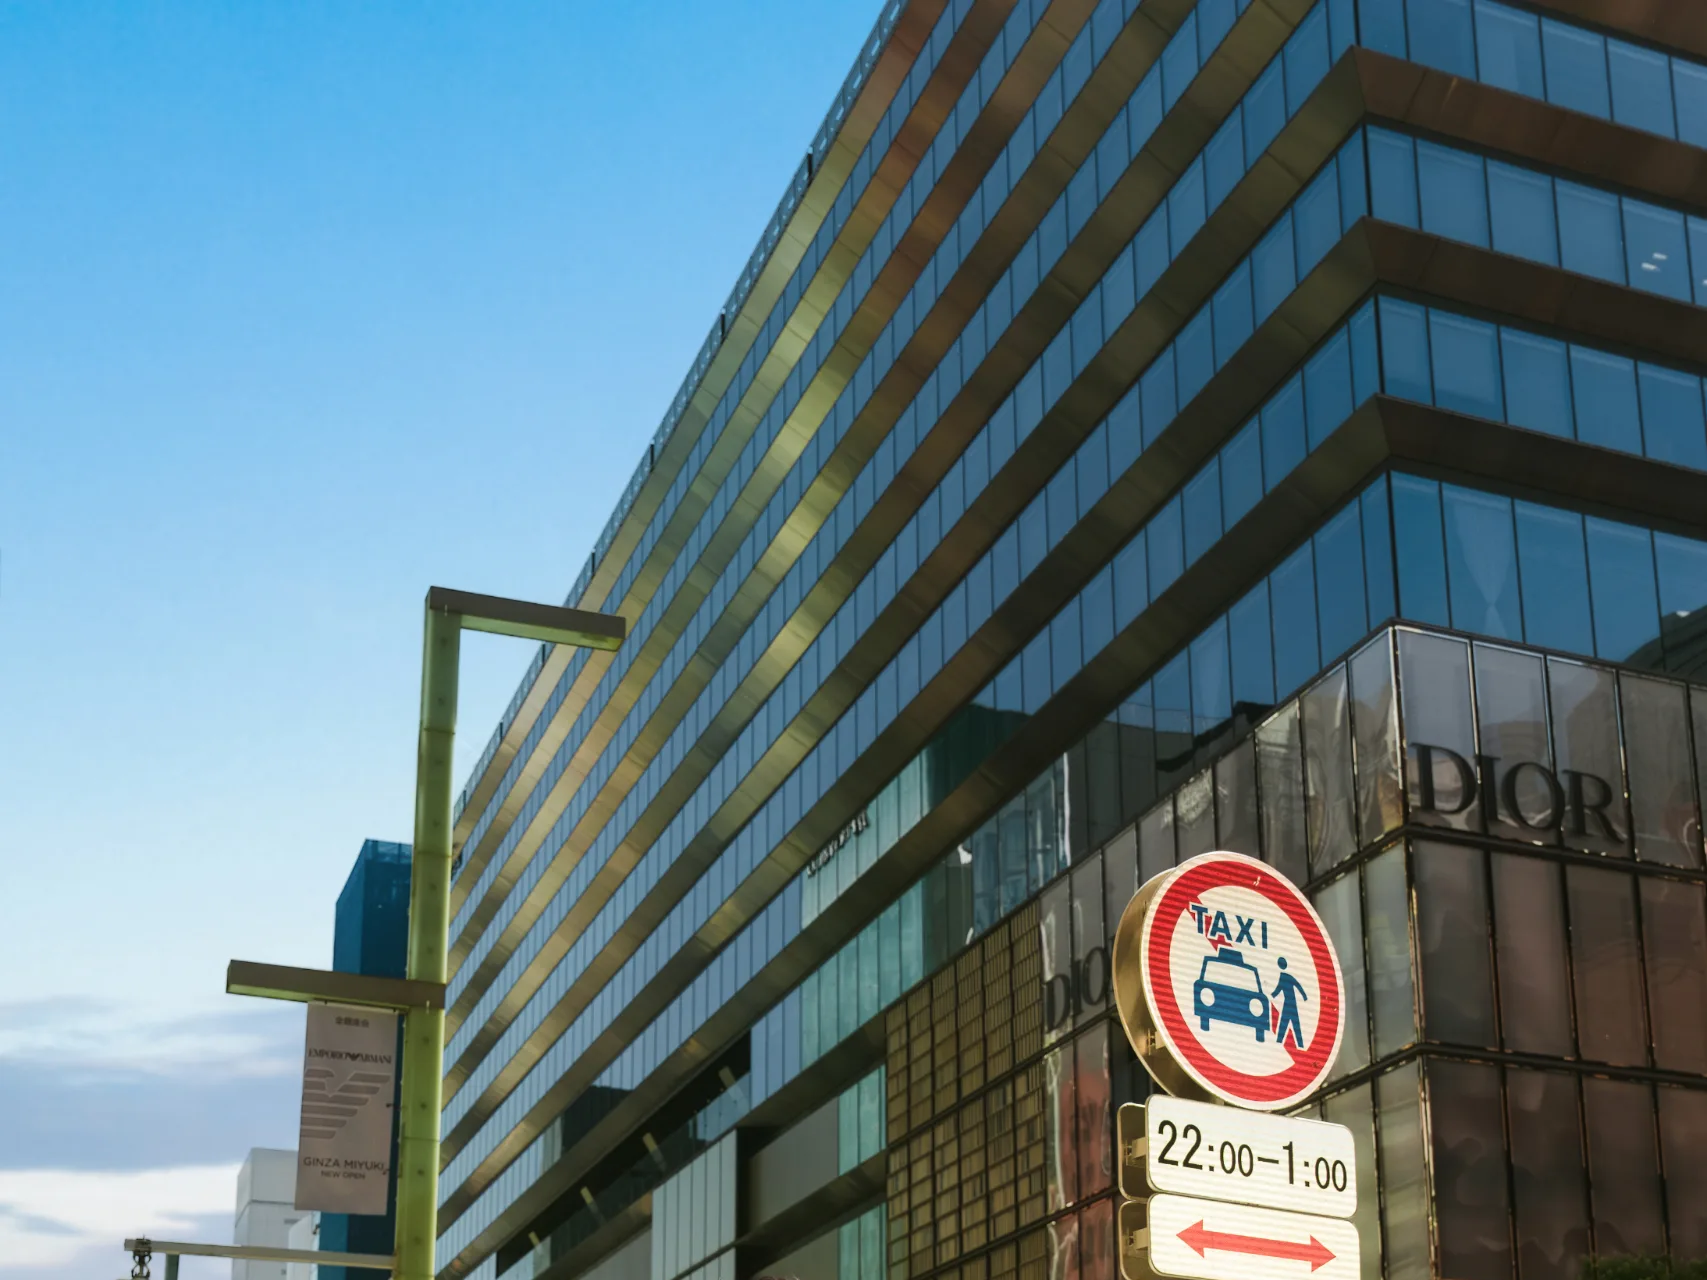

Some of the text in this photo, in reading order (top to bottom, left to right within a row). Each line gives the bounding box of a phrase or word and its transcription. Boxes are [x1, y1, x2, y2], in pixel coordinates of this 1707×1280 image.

[1410, 742, 1625, 844] DIOR
[1191, 904, 1268, 950] TAXI
[1041, 940, 1113, 1034] DIO
[303, 1156, 384, 1171] GINZA MIYUKI
[321, 1170, 366, 1180] NEW OPEN
